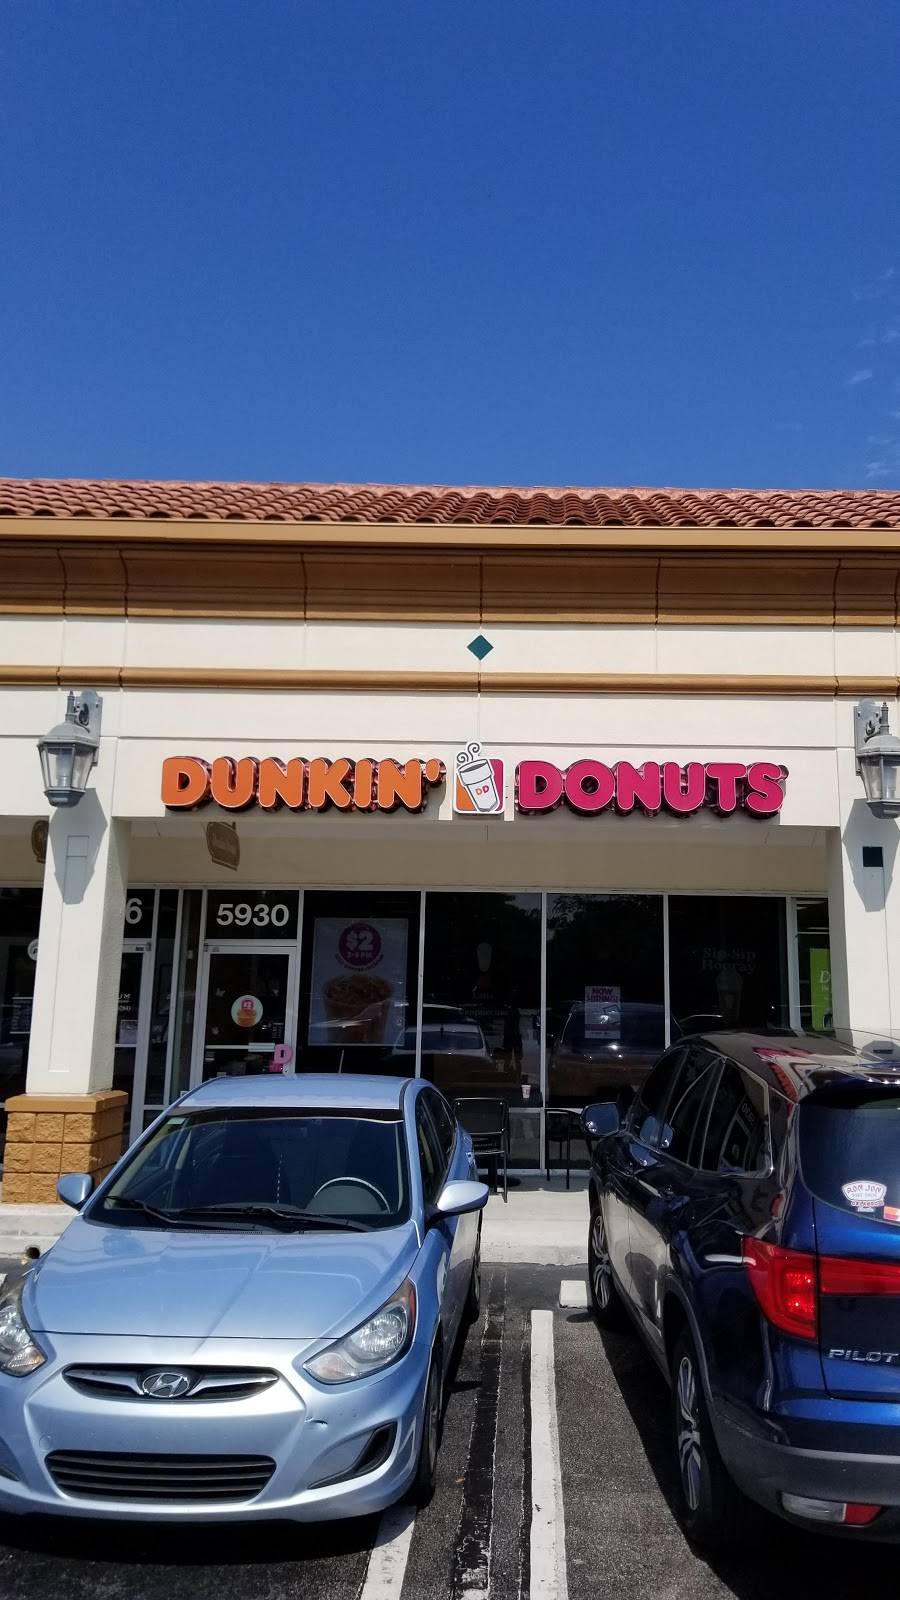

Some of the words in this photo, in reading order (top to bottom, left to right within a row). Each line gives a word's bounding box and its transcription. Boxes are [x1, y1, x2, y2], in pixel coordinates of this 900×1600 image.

[161, 756, 446, 812] DUNKIN'
[515, 758, 788, 818] DONUTS
[475, 784, 490, 796] DD
[216, 903, 290, 927] 5930
[345, 930, 374, 951] $2
[592, 988, 613, 996] NOW
[846, 1184, 863, 1194] RON
[866, 1184, 882, 1194] JON
[828, 1348, 899, 1363] PILOT
